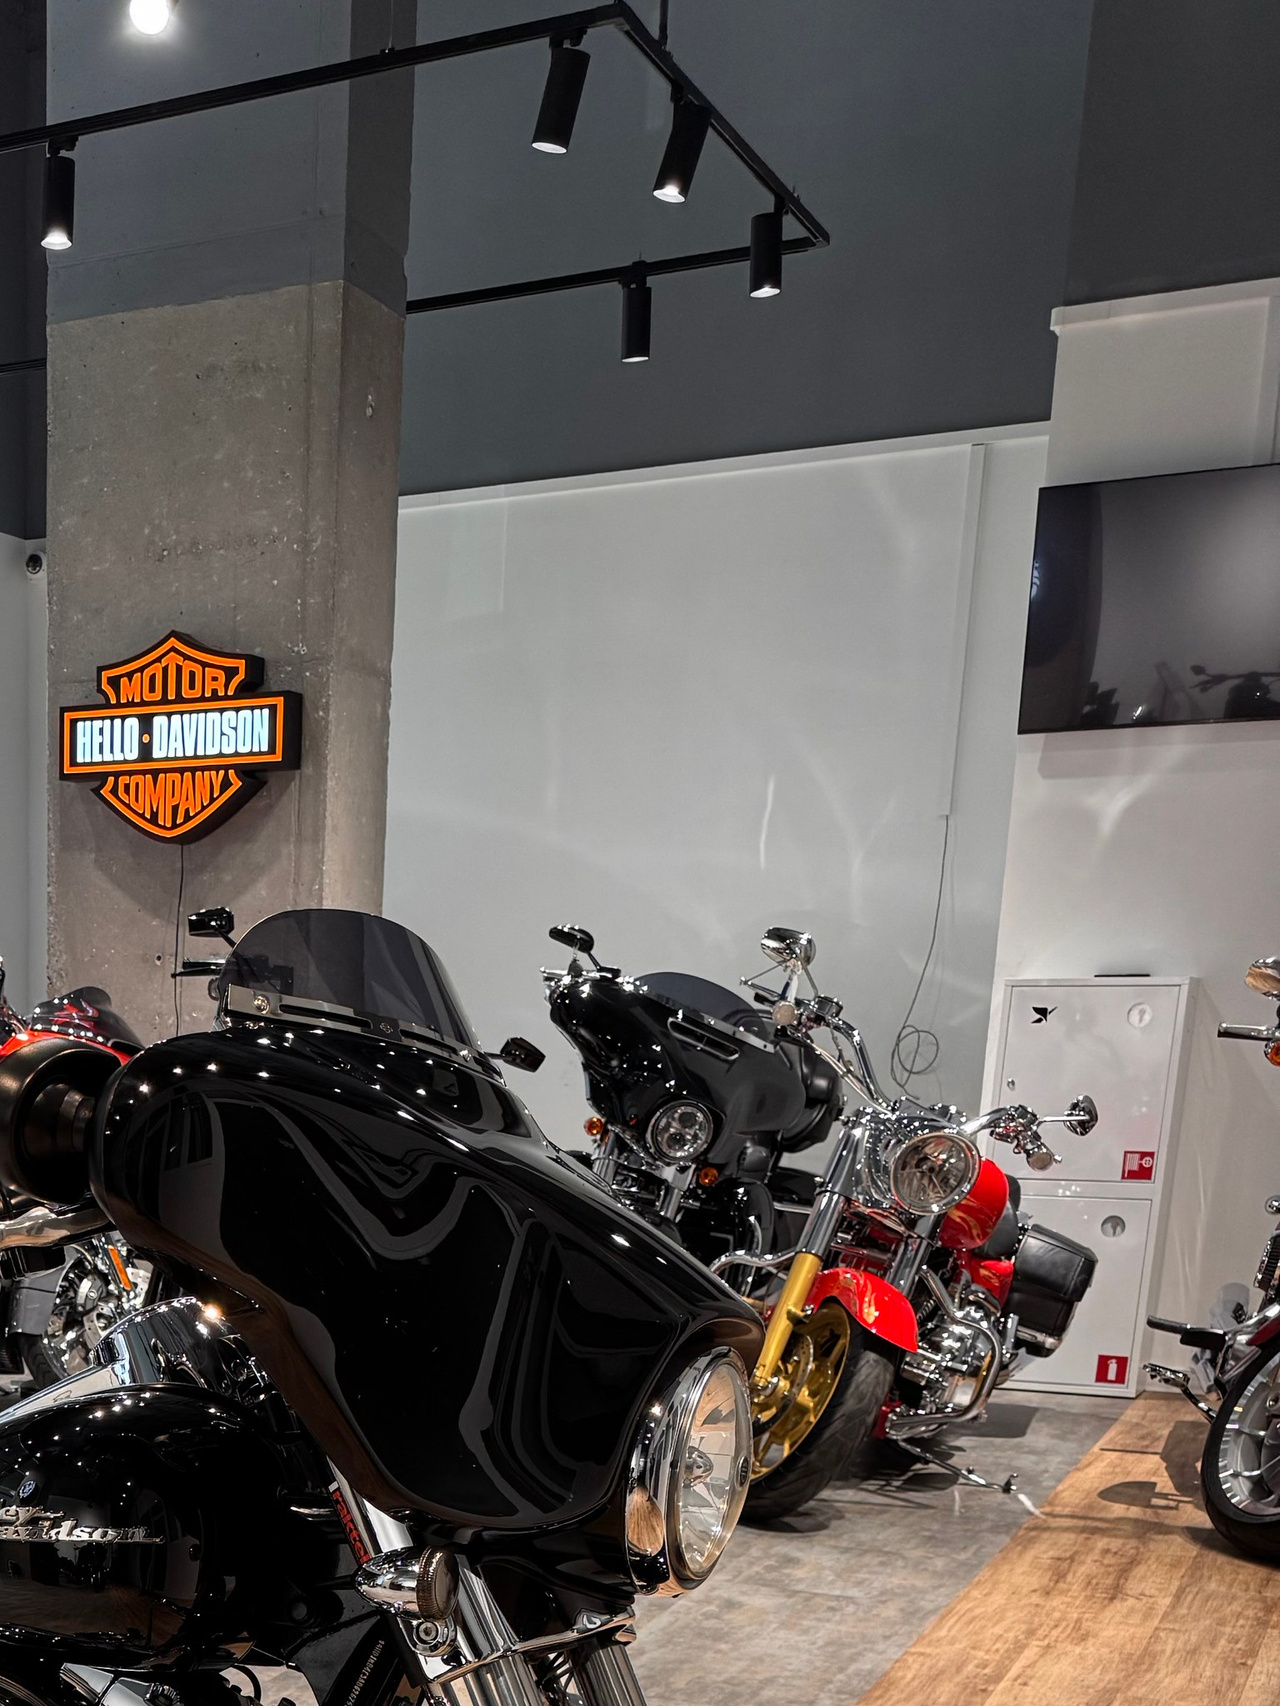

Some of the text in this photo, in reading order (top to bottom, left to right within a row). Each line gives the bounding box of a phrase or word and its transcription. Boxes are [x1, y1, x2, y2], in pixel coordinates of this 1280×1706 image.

[120, 652, 225, 703] MOTOR
[76, 708, 270, 763] HELLO DAVIDSON
[118, 770, 225, 827] COMPANY
